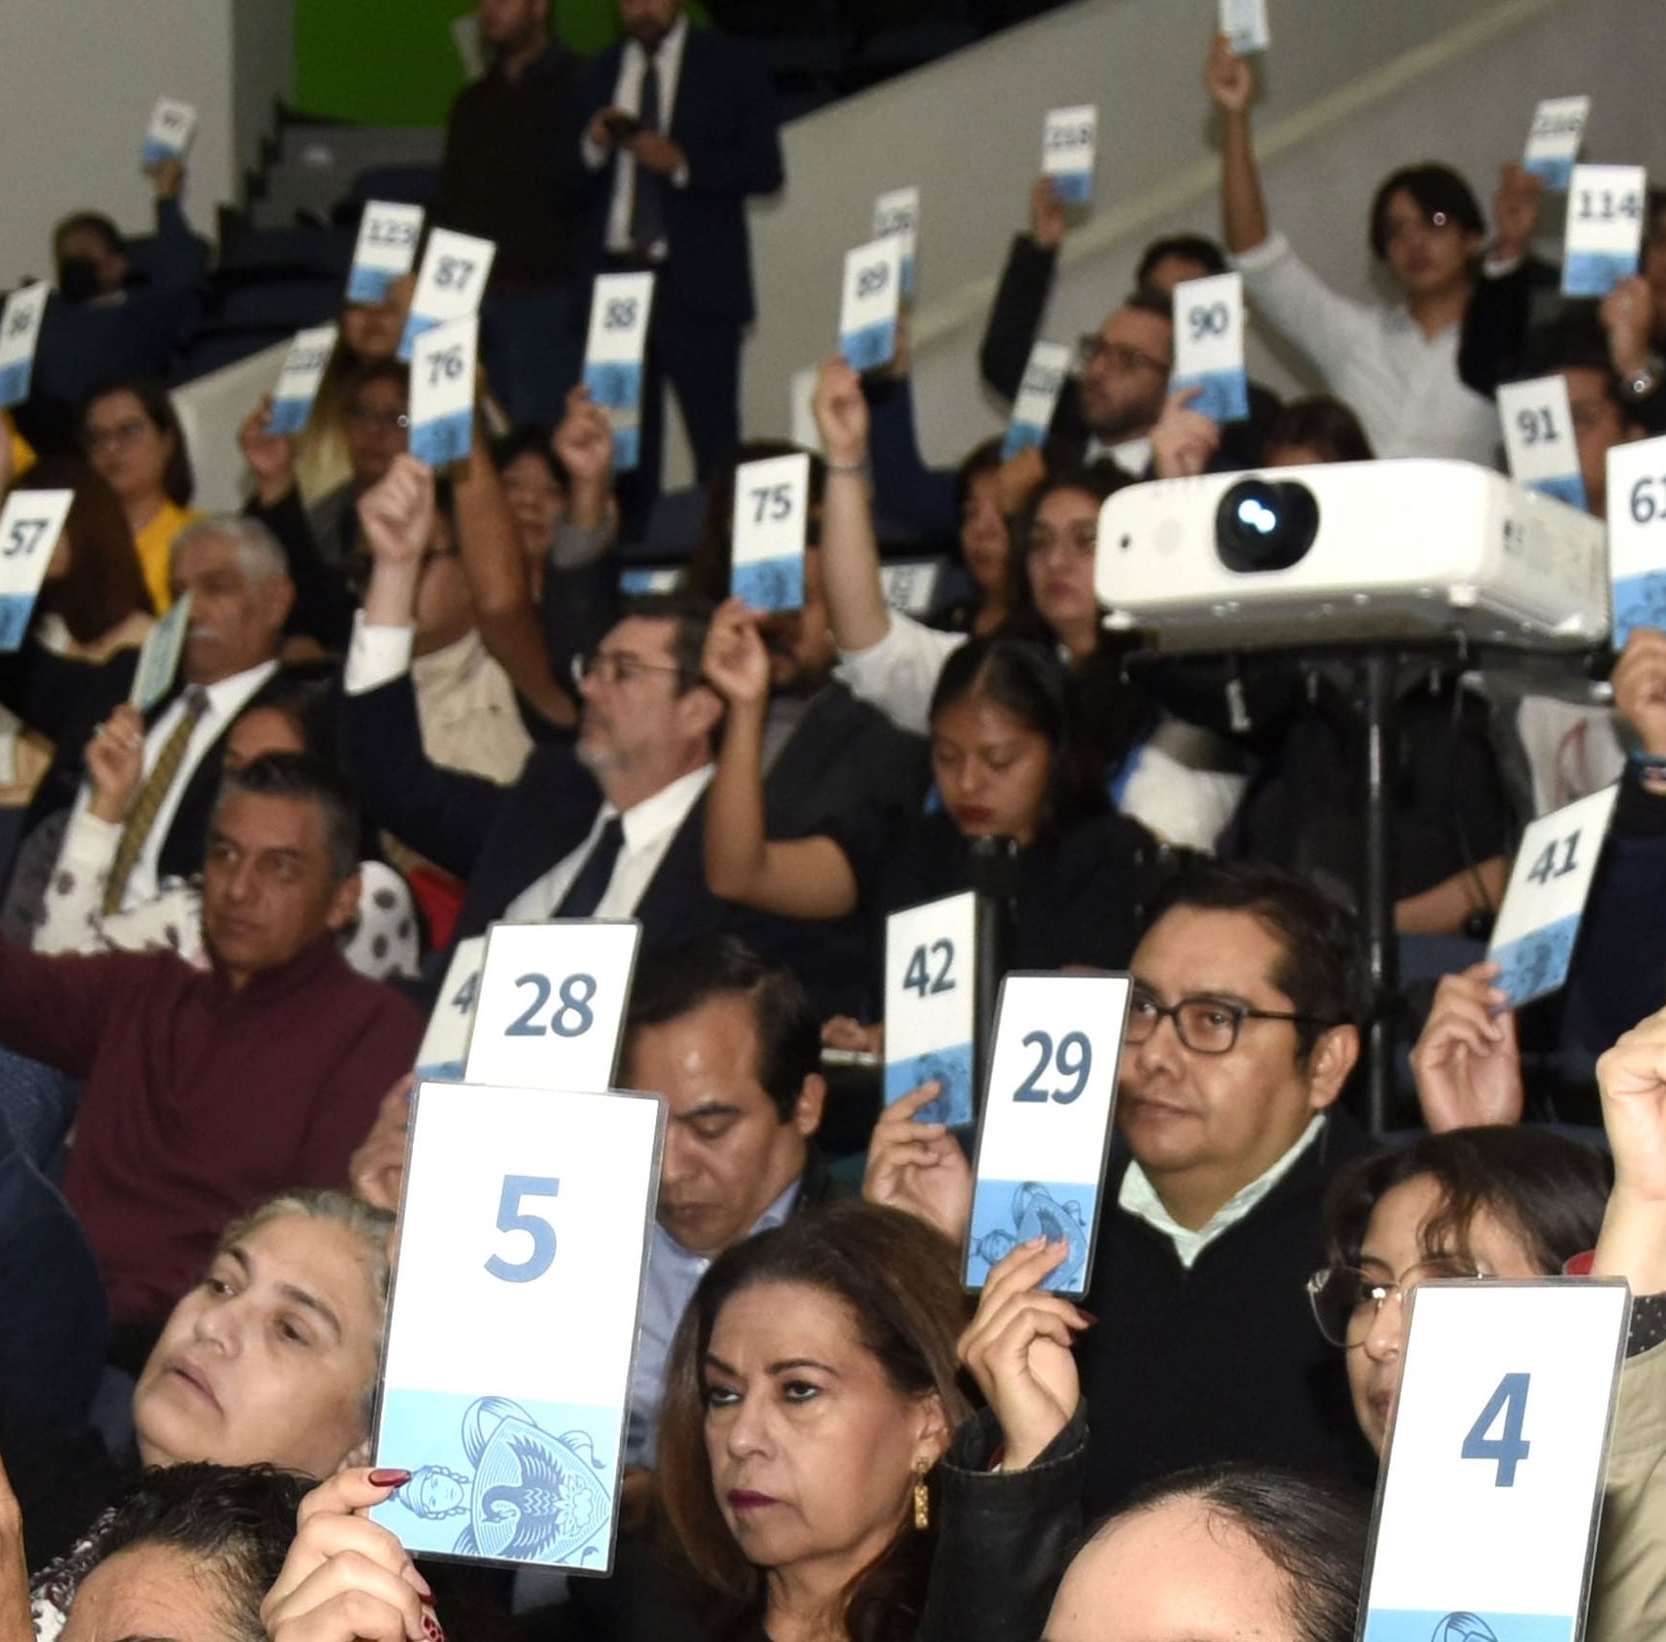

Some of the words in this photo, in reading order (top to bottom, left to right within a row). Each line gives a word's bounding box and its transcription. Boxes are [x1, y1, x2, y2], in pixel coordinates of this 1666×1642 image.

[1578, 190, 1639, 219] 114
[1190, 303, 1229, 340] 90
[425, 346, 463, 387] 76
[1518, 408, 1558, 443] 91
[751, 484, 792, 525] 75
[1, 519, 48, 555] 57
[1527, 831, 1581, 886] 41
[902, 938, 956, 997] 42
[451, 971, 476, 1013] 4
[505, 973, 598, 1038] 28
[1012, 1030, 1093, 1105] 29
[483, 1174, 560, 1283] 5
[1458, 1371, 1532, 1490] 4
